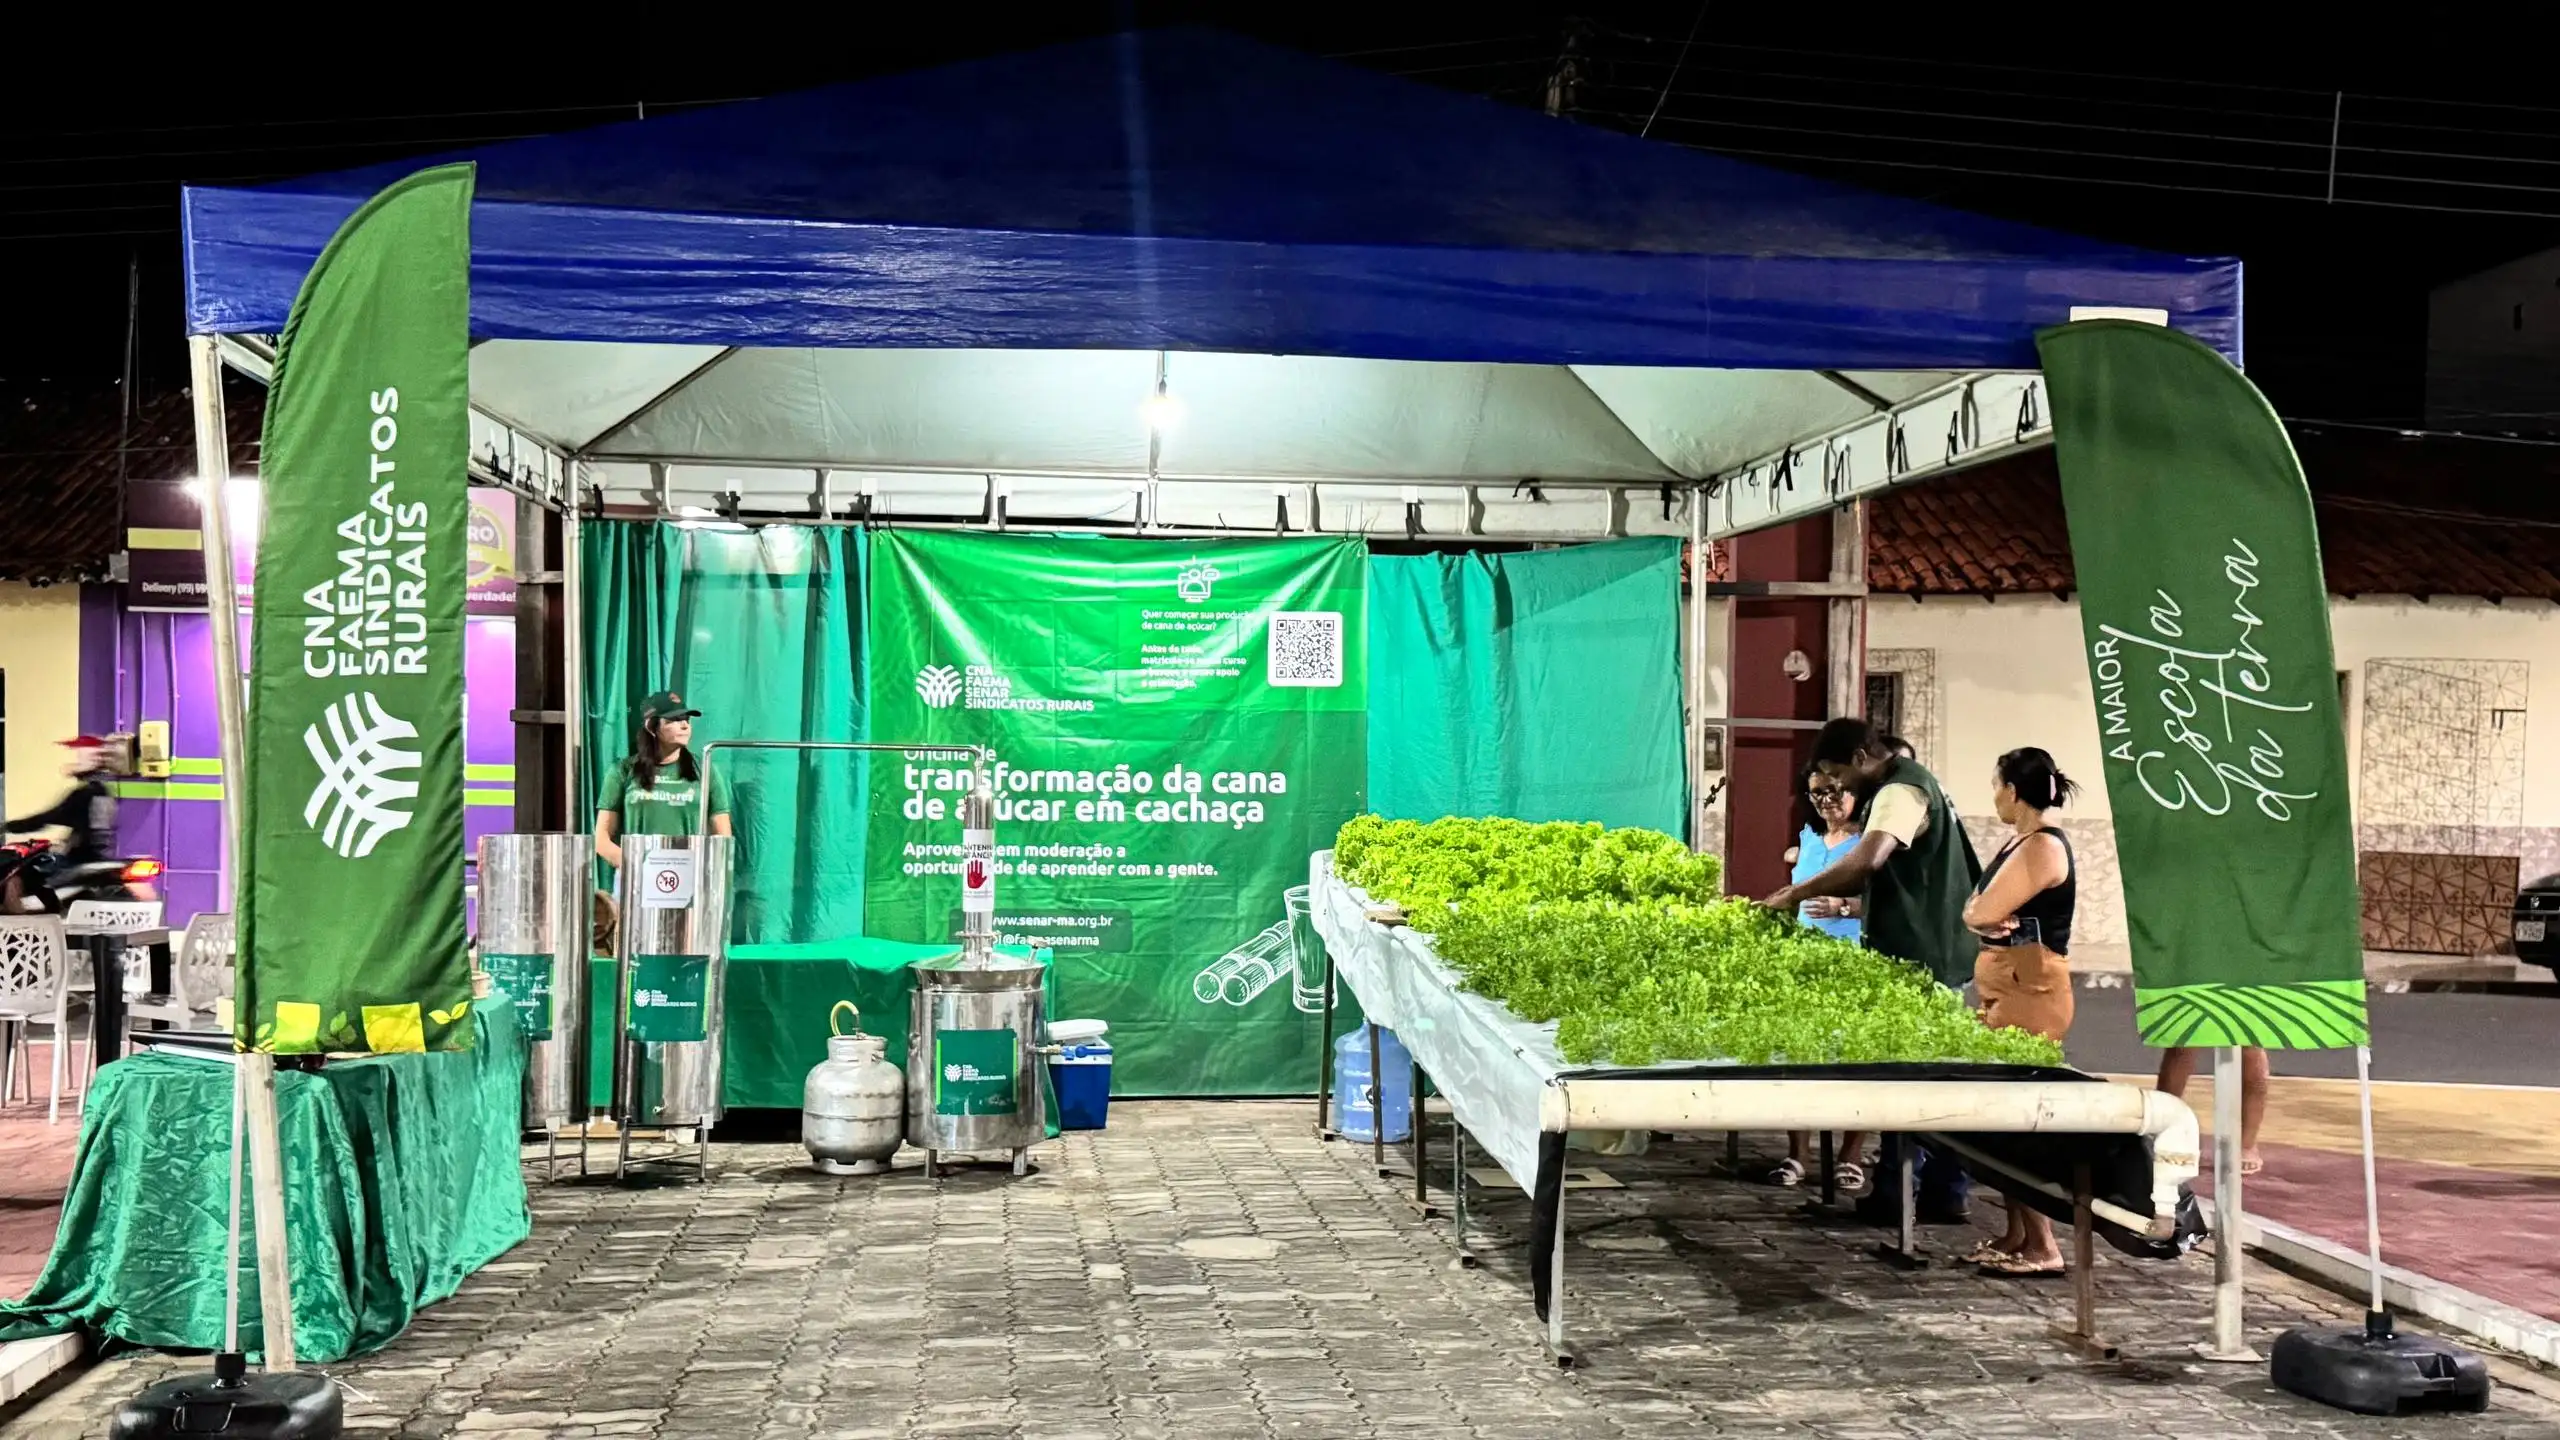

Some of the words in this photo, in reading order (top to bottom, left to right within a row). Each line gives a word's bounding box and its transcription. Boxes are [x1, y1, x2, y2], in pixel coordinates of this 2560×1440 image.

[365, 387, 399, 676] SINDICATOS
[337, 511, 367, 676] FAEMA
[394, 501, 428, 675] RURAIS
[1141, 609, 1163, 620] Quer
[1163, 610, 1200, 621] começar
[1200, 611, 1215, 620] sua
[303, 579, 336, 678] CNA
[1141, 620, 1153, 631] de
[1153, 622, 1174, 631] cana
[1174, 620, 1186, 631] de
[1186, 621, 1217, 632] açúcar?
[965, 664, 992, 676] CNA
[1221, 657, 1247, 665] curso
[965, 676, 1012, 688] FAEMA
[2094, 637, 2131, 735] MAIOR
[965, 687, 1009, 699] SENAR
[2098, 588, 2237, 816] Escola
[964, 698, 1045, 711] SINDICATOS
[1047, 699, 1095, 712] RURAIS
[2108, 740, 2135, 761] A
[904, 761, 1153, 800] transformação
[1162, 763, 1202, 793] da
[1212, 770, 1287, 795] cana
[2216, 728, 2318, 822] da
[903, 789, 945, 820] de
[955, 790, 1066, 822] aúcar
[1075, 800, 1125, 822] em
[1135, 793, 1264, 830] cachaça
[995, 845, 1020, 857] em
[1025, 842, 1113, 860] moderação
[1117, 846, 1126, 857] a
[1016, 860, 1037, 874] de
[1041, 861, 1114, 877] aprender
[1118, 864, 1151, 876] com
[1154, 865, 1164, 876] a
[1168, 863, 1218, 878] gente.
